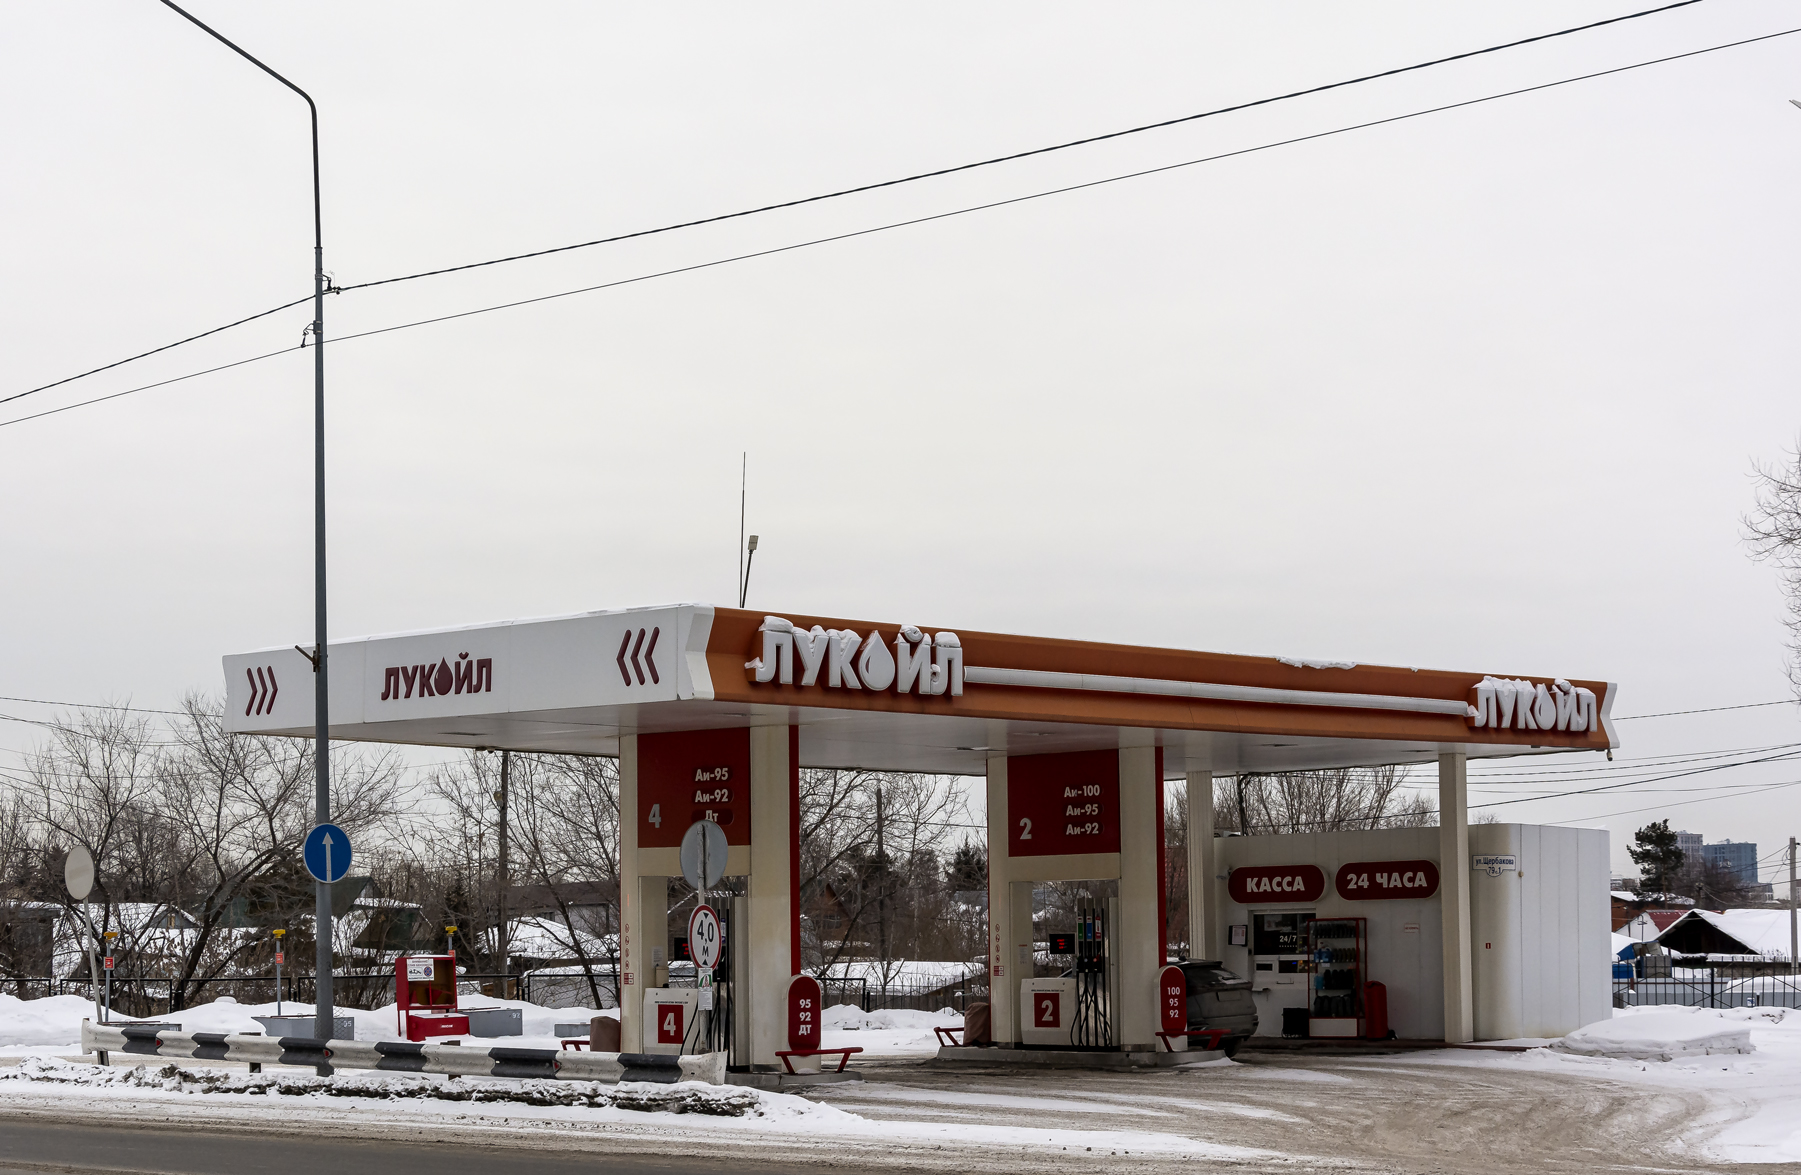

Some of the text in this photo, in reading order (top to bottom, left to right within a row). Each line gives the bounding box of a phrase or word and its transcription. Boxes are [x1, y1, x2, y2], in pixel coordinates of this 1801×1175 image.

[752, 625, 964, 697] ЛУКОЙЛ
[381, 651, 493, 701] ЛУКОЙЛ
[1474, 679, 1598, 732] ЛУКОЙЛ
[694, 767, 729, 782] Аи-95
[694, 788, 729, 803] Аи-92
[1064, 784, 1100, 798] Аи-100
[648, 803, 662, 829] 4
[1065, 803, 1099, 817] Аи-95
[1019, 817, 1032, 840] 2
[1065, 822, 1099, 836] Аи-92
[1246, 876, 1305, 893] КАССА
[1346, 871, 1428, 890] 24 ЧАСА
[1279, 935, 1297, 943] 24/7
[1167, 986, 1181, 996] 100
[799, 998, 812, 1009] 95
[1169, 997, 1179, 1007] 95
[799, 1011, 812, 1022] 92
[1041, 999, 1053, 1021] 2
[1169, 1009, 1179, 1018] 92
[663, 1012, 676, 1036] 4
[798, 1024, 811, 1036] ДТ
